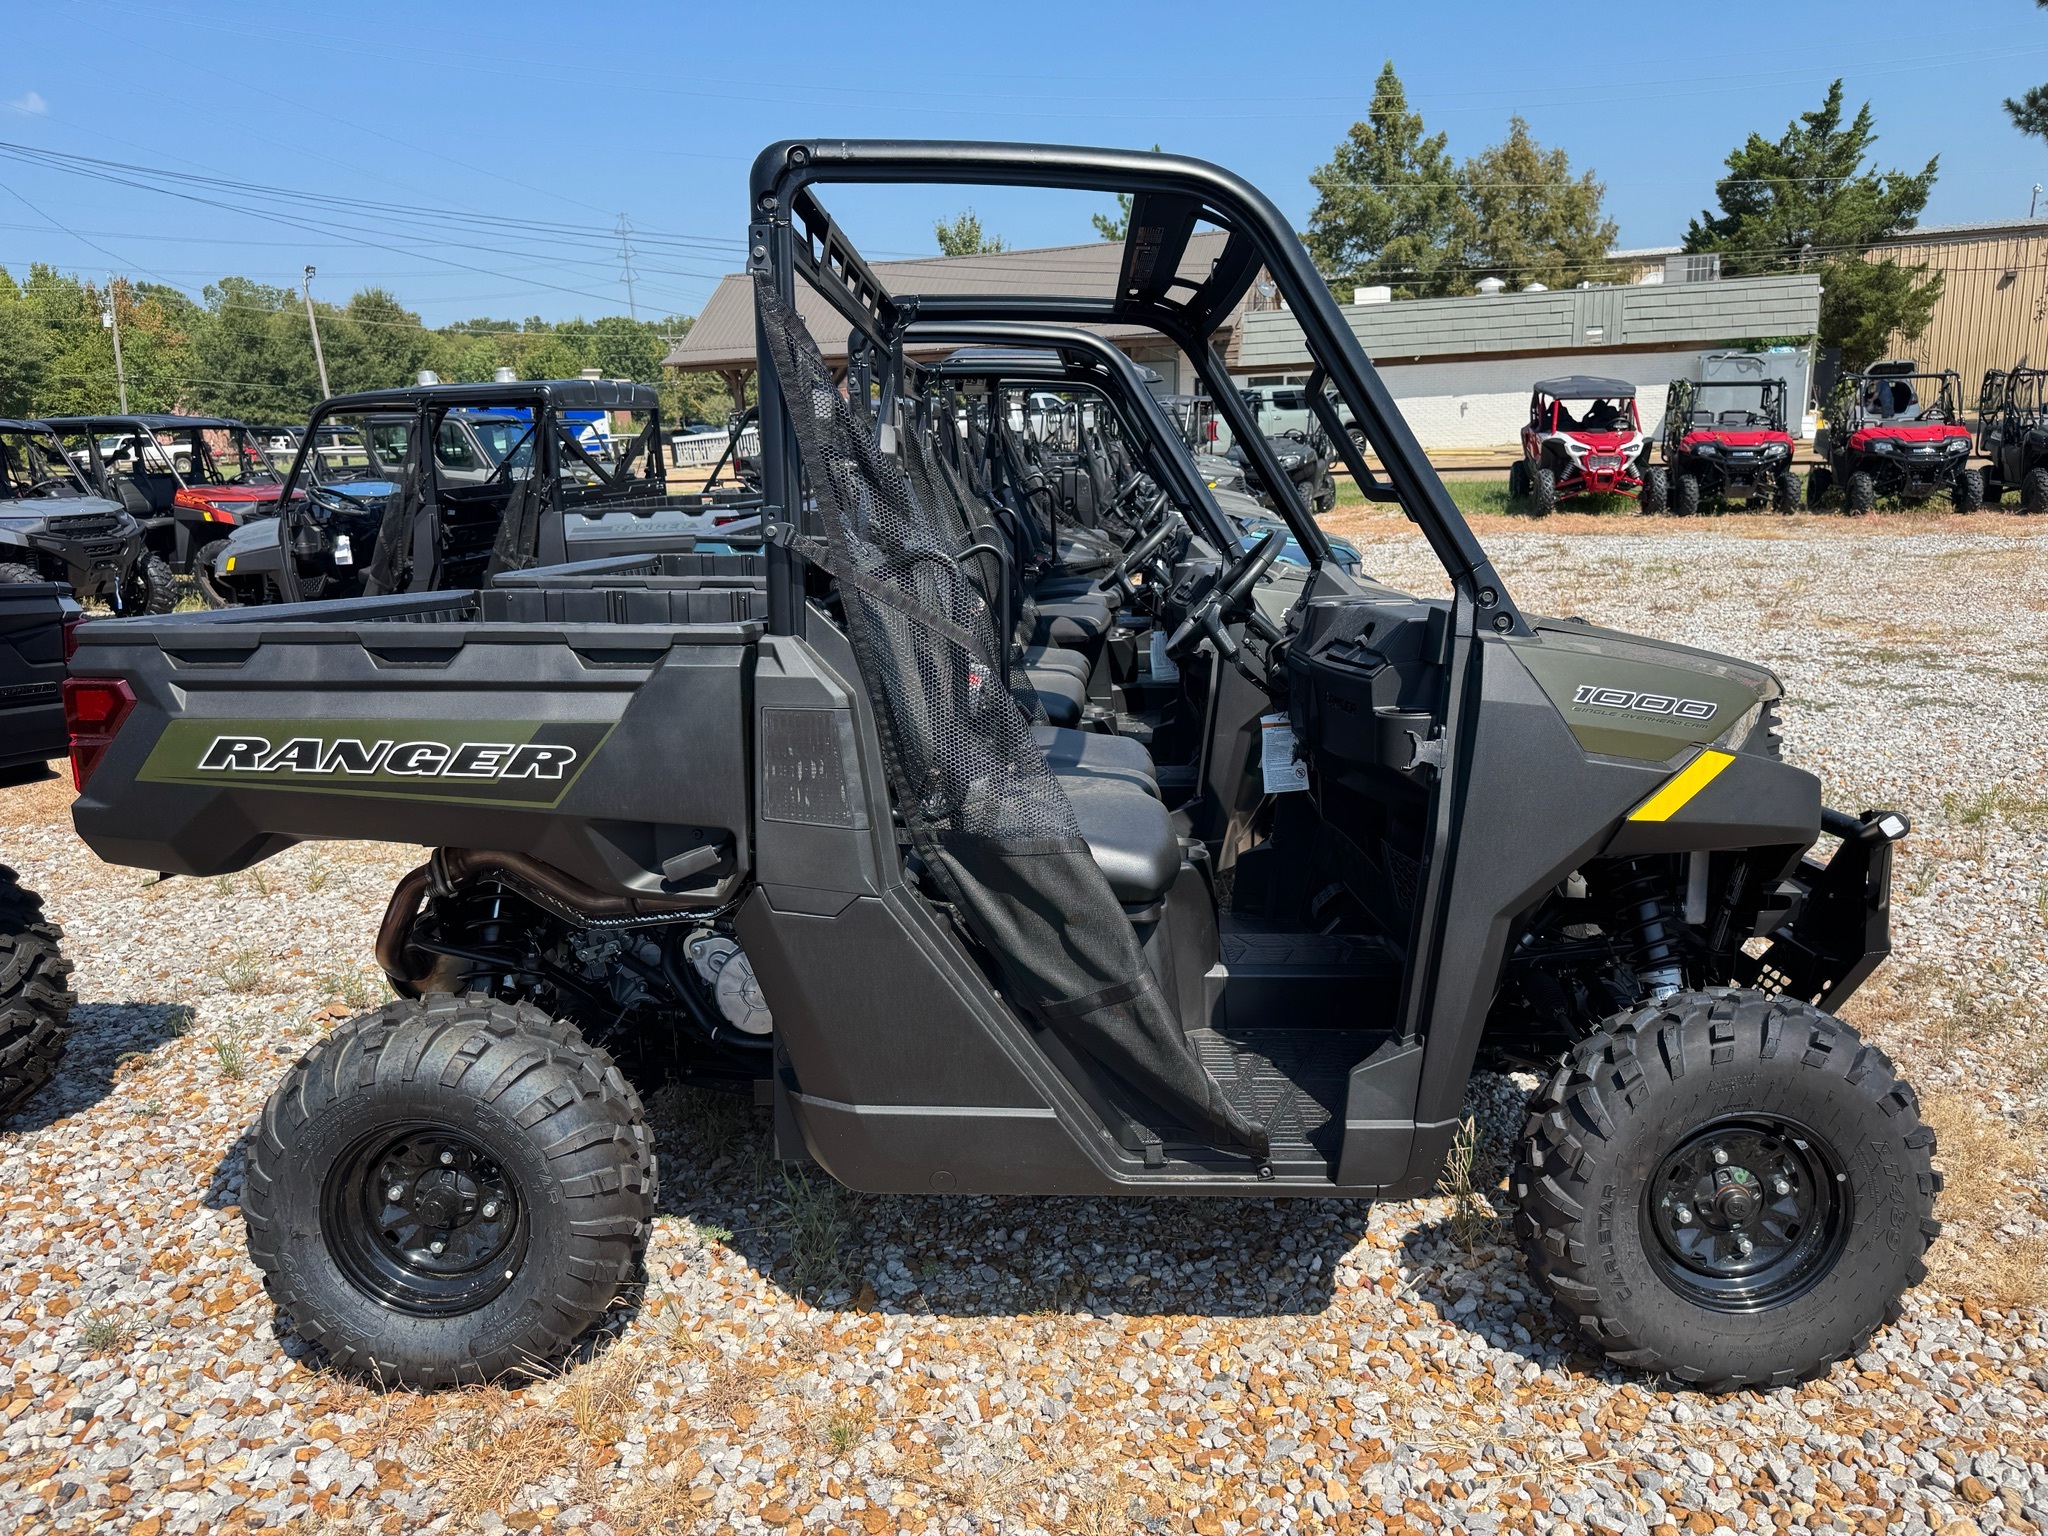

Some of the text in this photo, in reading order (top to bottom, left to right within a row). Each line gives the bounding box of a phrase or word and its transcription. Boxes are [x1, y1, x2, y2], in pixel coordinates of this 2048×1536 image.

[611, 522, 693, 533] RANGER
[1572, 706, 1709, 730] SINGLE OVERHEAD CAM
[1573, 685, 1718, 721] 1000
[197, 735, 578, 781] RANGER
[473, 1102, 559, 1204] CARLSTAR
[1870, 1140, 1905, 1252] AT489
[1597, 1182, 1633, 1302] CARLSTAR
[281, 1252, 366, 1342] AT489
